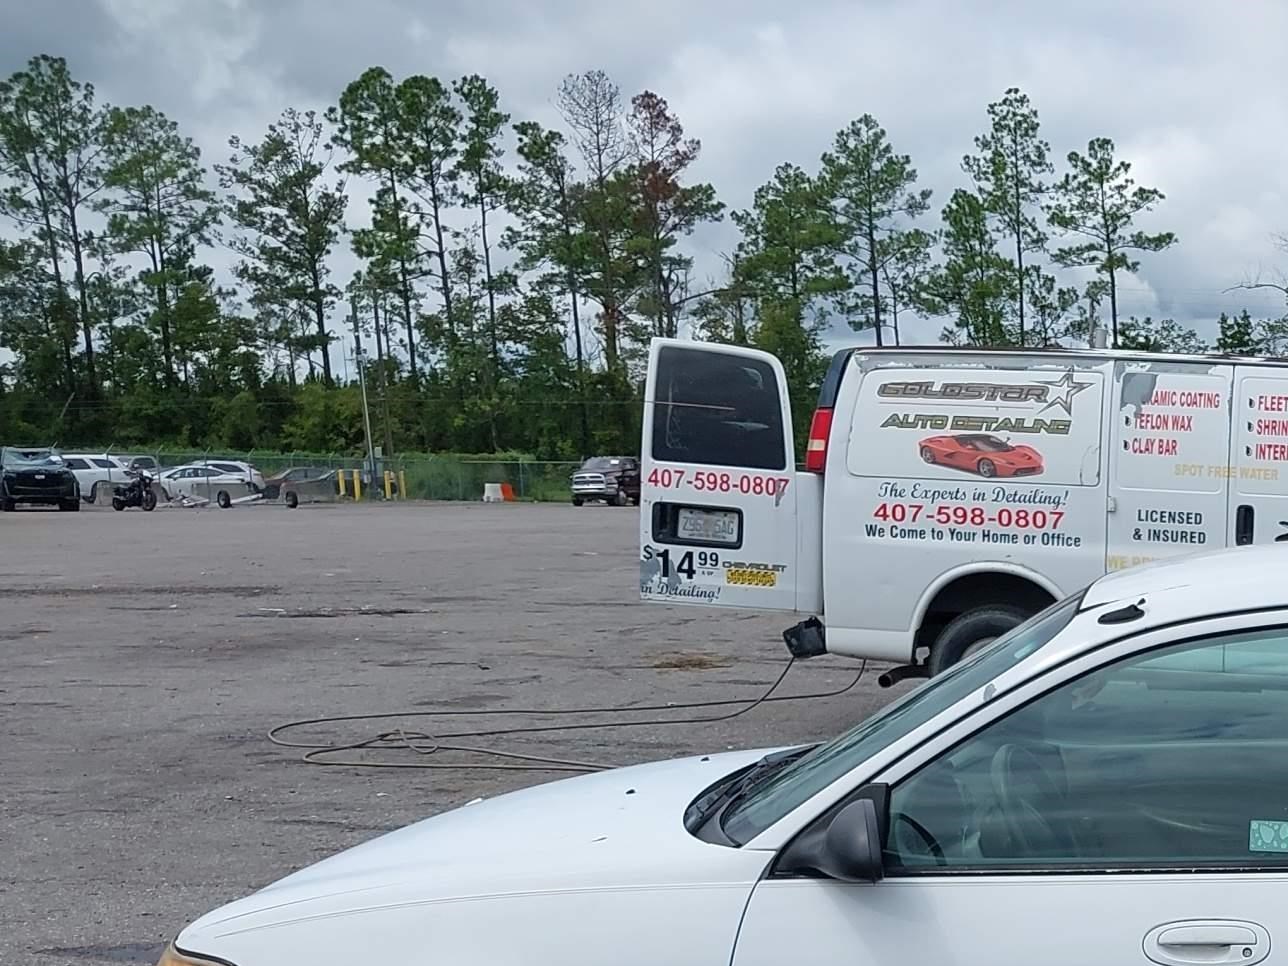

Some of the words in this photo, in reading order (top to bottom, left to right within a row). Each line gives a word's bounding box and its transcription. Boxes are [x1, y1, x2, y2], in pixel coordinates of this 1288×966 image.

[1179, 391, 1220, 408] COATING
[1258, 395, 1288, 412] FLEET
[880, 413, 949, 430] AUTO
[950, 415, 1072, 435] DETAILING
[1171, 415, 1193, 431] WAX
[1132, 437, 1156, 454] CLAY
[1158, 438, 1178, 456] BAR
[1174, 463, 1204, 477] SPOT
[1207, 465, 1237, 479] FREE
[1239, 467, 1279, 481] WATER
[648, 468, 790, 496] 407-598-0807
[878, 481, 907, 499] The
[910, 482, 967, 504] Experts
[972, 489, 987, 502] in
[991, 486, 1069, 510] Detailing!
[873, 503, 1065, 529] 407-598-0807
[1137, 509, 1203, 525] LICENSED
[865, 524, 886, 538] We
[889, 525, 926, 540] Come
[931, 528, 944, 541] to
[948, 528, 977, 543] Your
[982, 530, 1019, 545] Home
[1023, 533, 1037, 545] or
[1041, 533, 1081, 547] Office
[1132, 528, 1143, 541] &
[1147, 529, 1206, 544] INSURED
[657, 583, 721, 602] Detailing!
